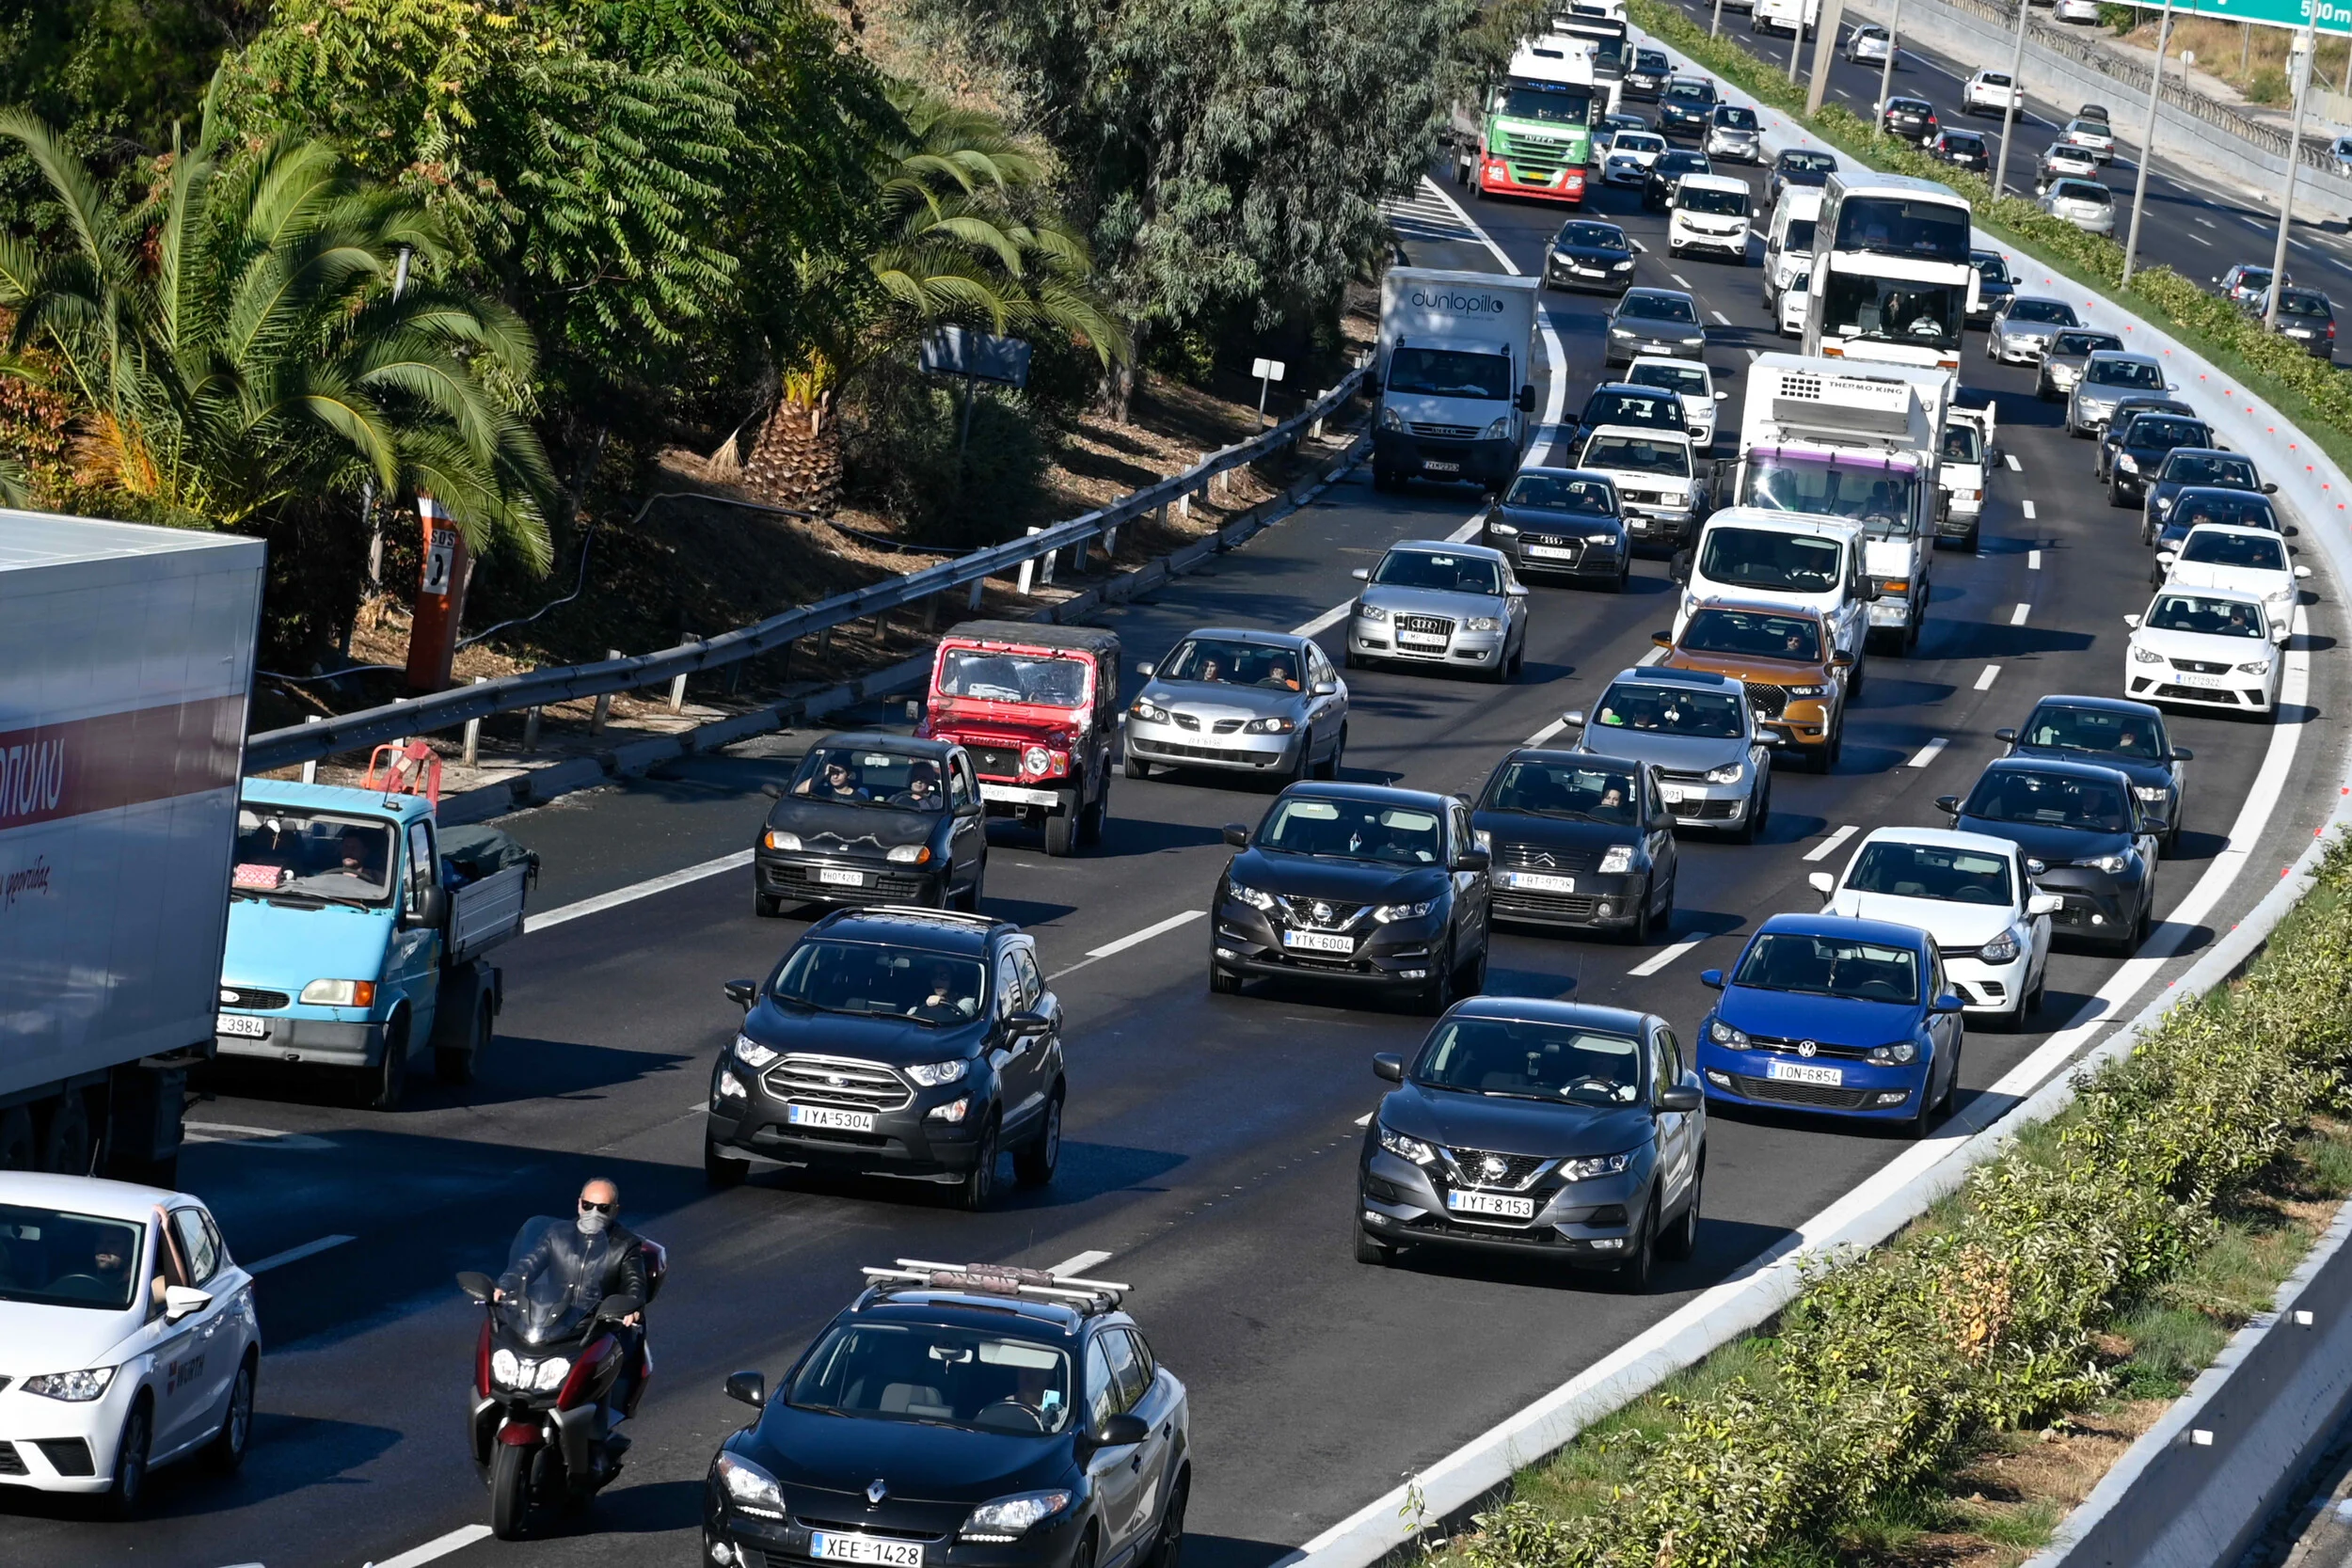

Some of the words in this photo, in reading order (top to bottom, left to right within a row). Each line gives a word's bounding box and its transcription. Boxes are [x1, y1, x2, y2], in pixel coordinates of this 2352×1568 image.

[1411, 290, 1503, 314] dunlopillo
[1829, 381, 1872, 391] THERMO
[431, 531, 455, 546] SOS
